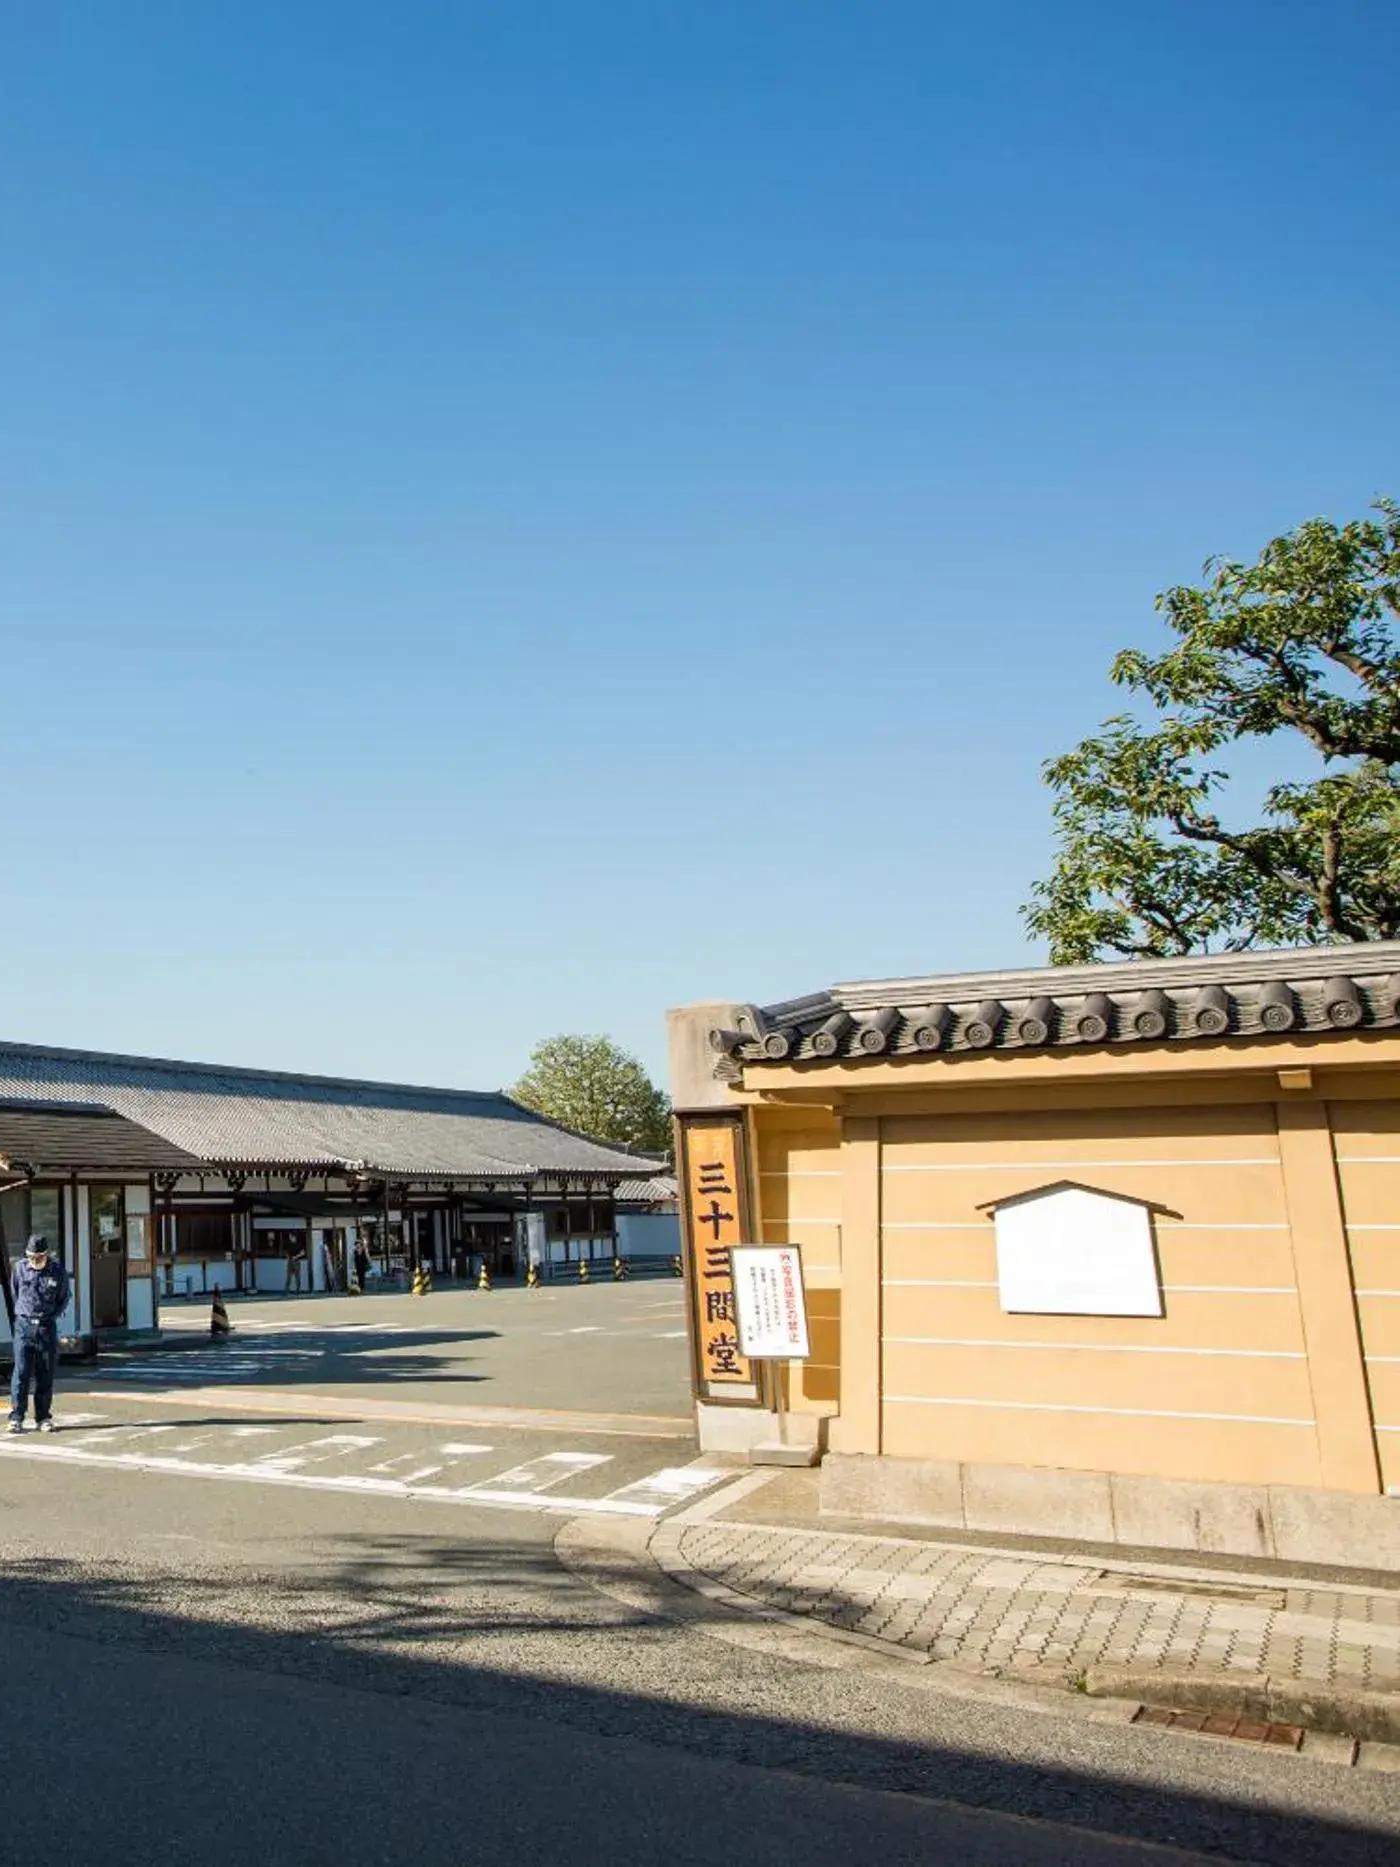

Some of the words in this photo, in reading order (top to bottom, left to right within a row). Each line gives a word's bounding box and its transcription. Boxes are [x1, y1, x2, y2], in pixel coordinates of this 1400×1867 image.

[697, 1161, 743, 1376] 三十三間堂
